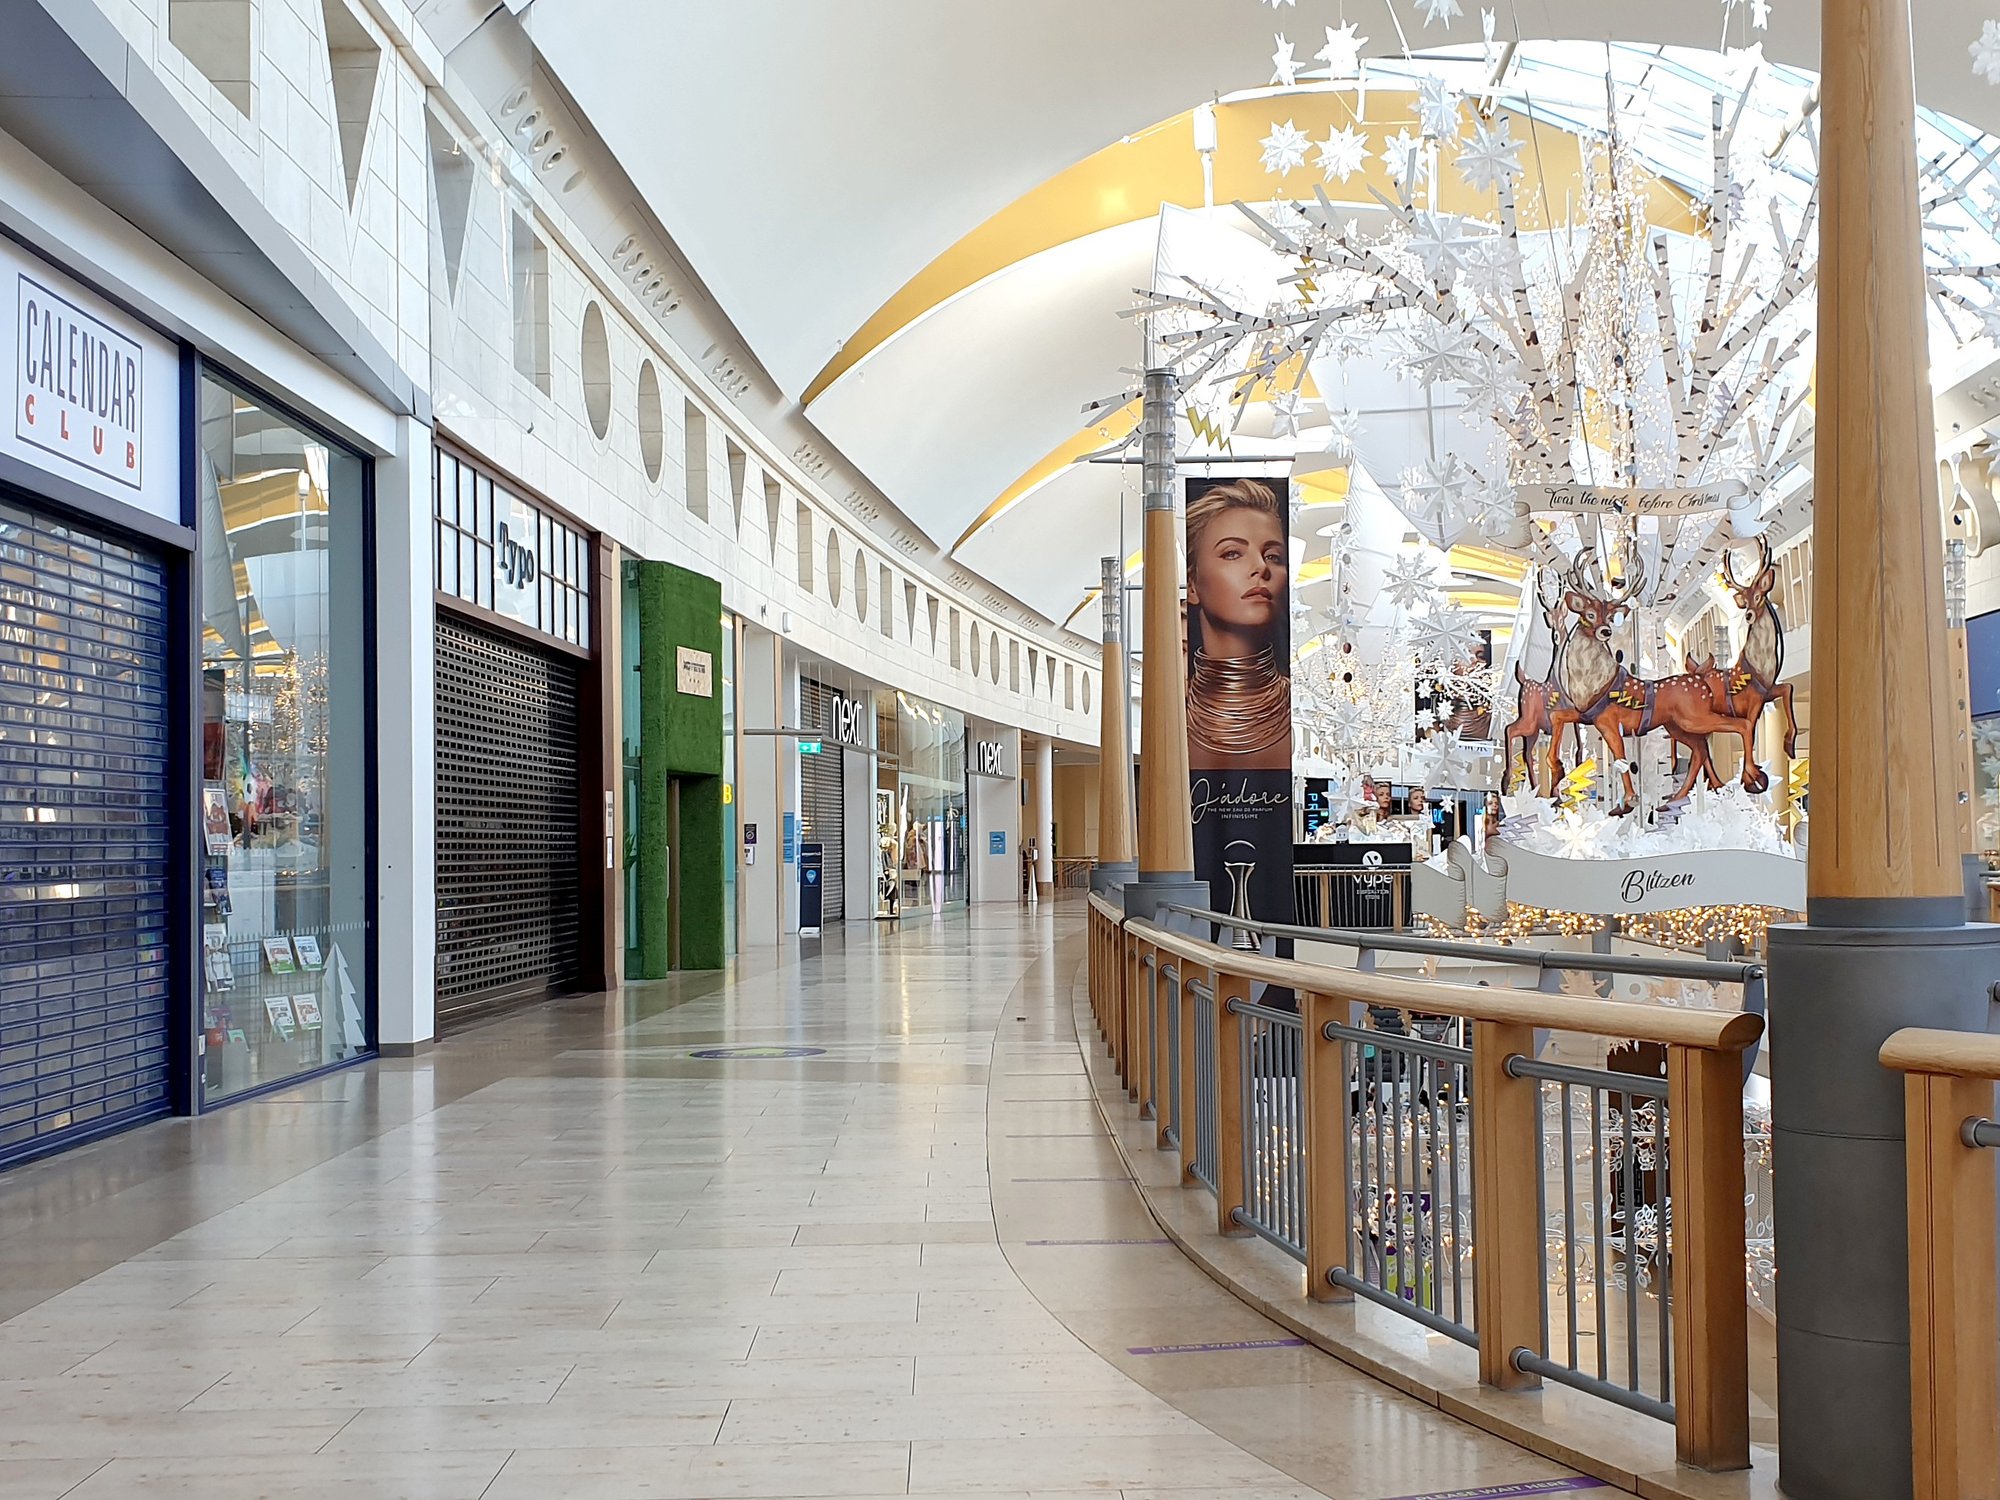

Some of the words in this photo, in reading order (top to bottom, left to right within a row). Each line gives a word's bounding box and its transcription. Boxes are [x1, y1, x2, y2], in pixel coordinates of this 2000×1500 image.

[26, 300, 135, 433] CALENDAR
[25, 394, 135, 469] CLUB
[1580, 491, 1598, 505] the
[1638, 493, 1673, 513] before
[499, 521, 535, 589] Typo
[833, 696, 862, 746] next
[979, 741, 1003, 775] next
[1190, 778, 1289, 824] J'adore
[1353, 874, 1394, 888] vype
[1621, 870, 1696, 904] Blitzen
[1415, 1489, 1478, 1500] PLEASE
[1479, 1485, 1523, 1496] WAIT
[1523, 1479, 1569, 1490] HERE
